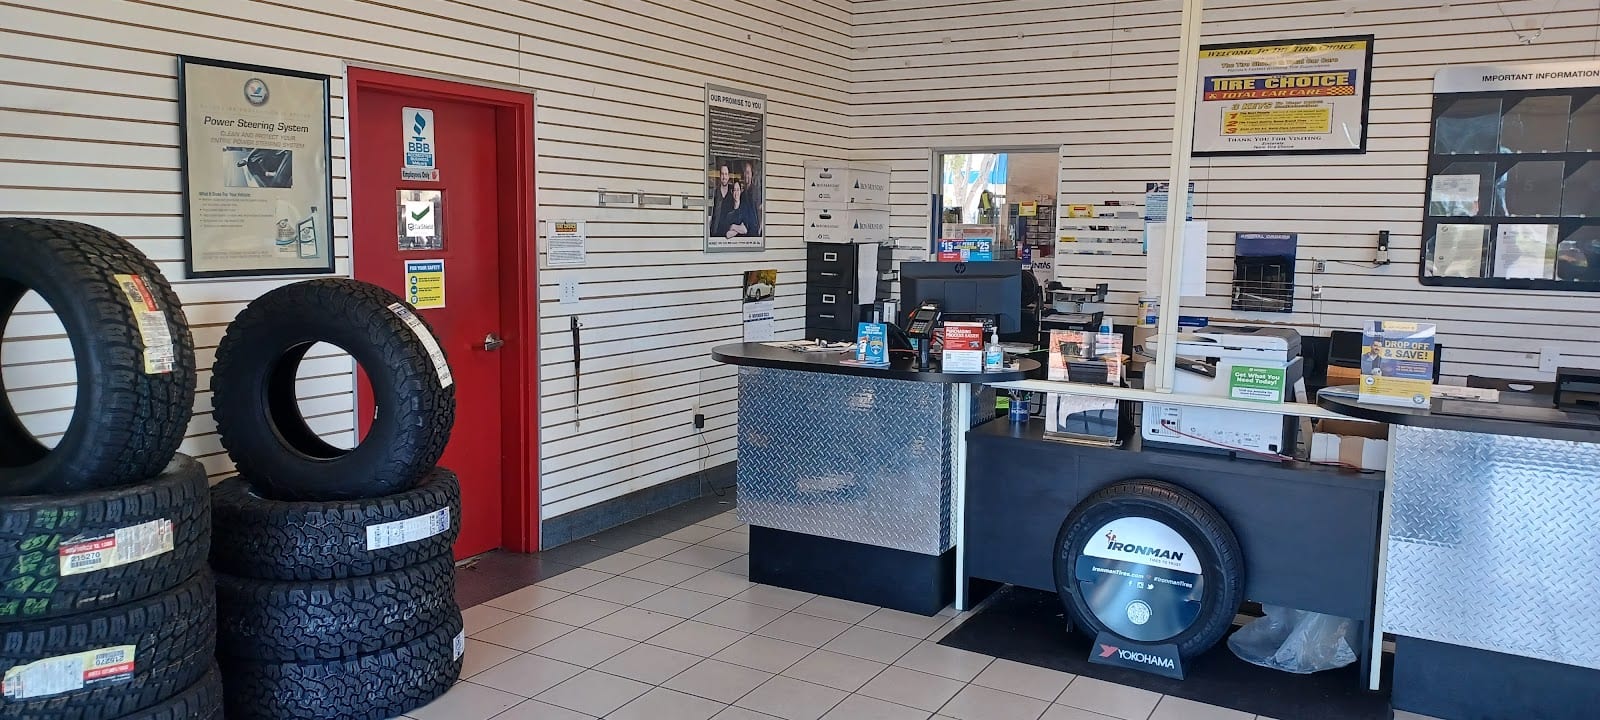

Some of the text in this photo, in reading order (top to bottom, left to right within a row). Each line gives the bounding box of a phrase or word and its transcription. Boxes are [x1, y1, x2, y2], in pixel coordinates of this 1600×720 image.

[1208, 49, 1252, 57] WELCOME
[1482, 70, 1600, 82] IMPORTANT INFORMATION
[1211, 74, 1349, 91] TIRE CHOICE
[710, 94, 721, 102] OUR
[722, 96, 744, 106] PROMISE
[1222, 91, 1256, 99] TOTAL
[203, 116, 309, 133] Power Steering System
[408, 142, 430, 152] BBB
[402, 170, 430, 180] Employees Only
[941, 241, 954, 250] $15
[977, 241, 990, 250] $25
[1384, 339, 1430, 350] DROP OFF
[1384, 348, 1428, 360] & SAVE!
[70, 551, 101, 562] 215270
[1107, 541, 1183, 561] IRONMAN
[1118, 648, 1175, 669] YOKOHAMA
